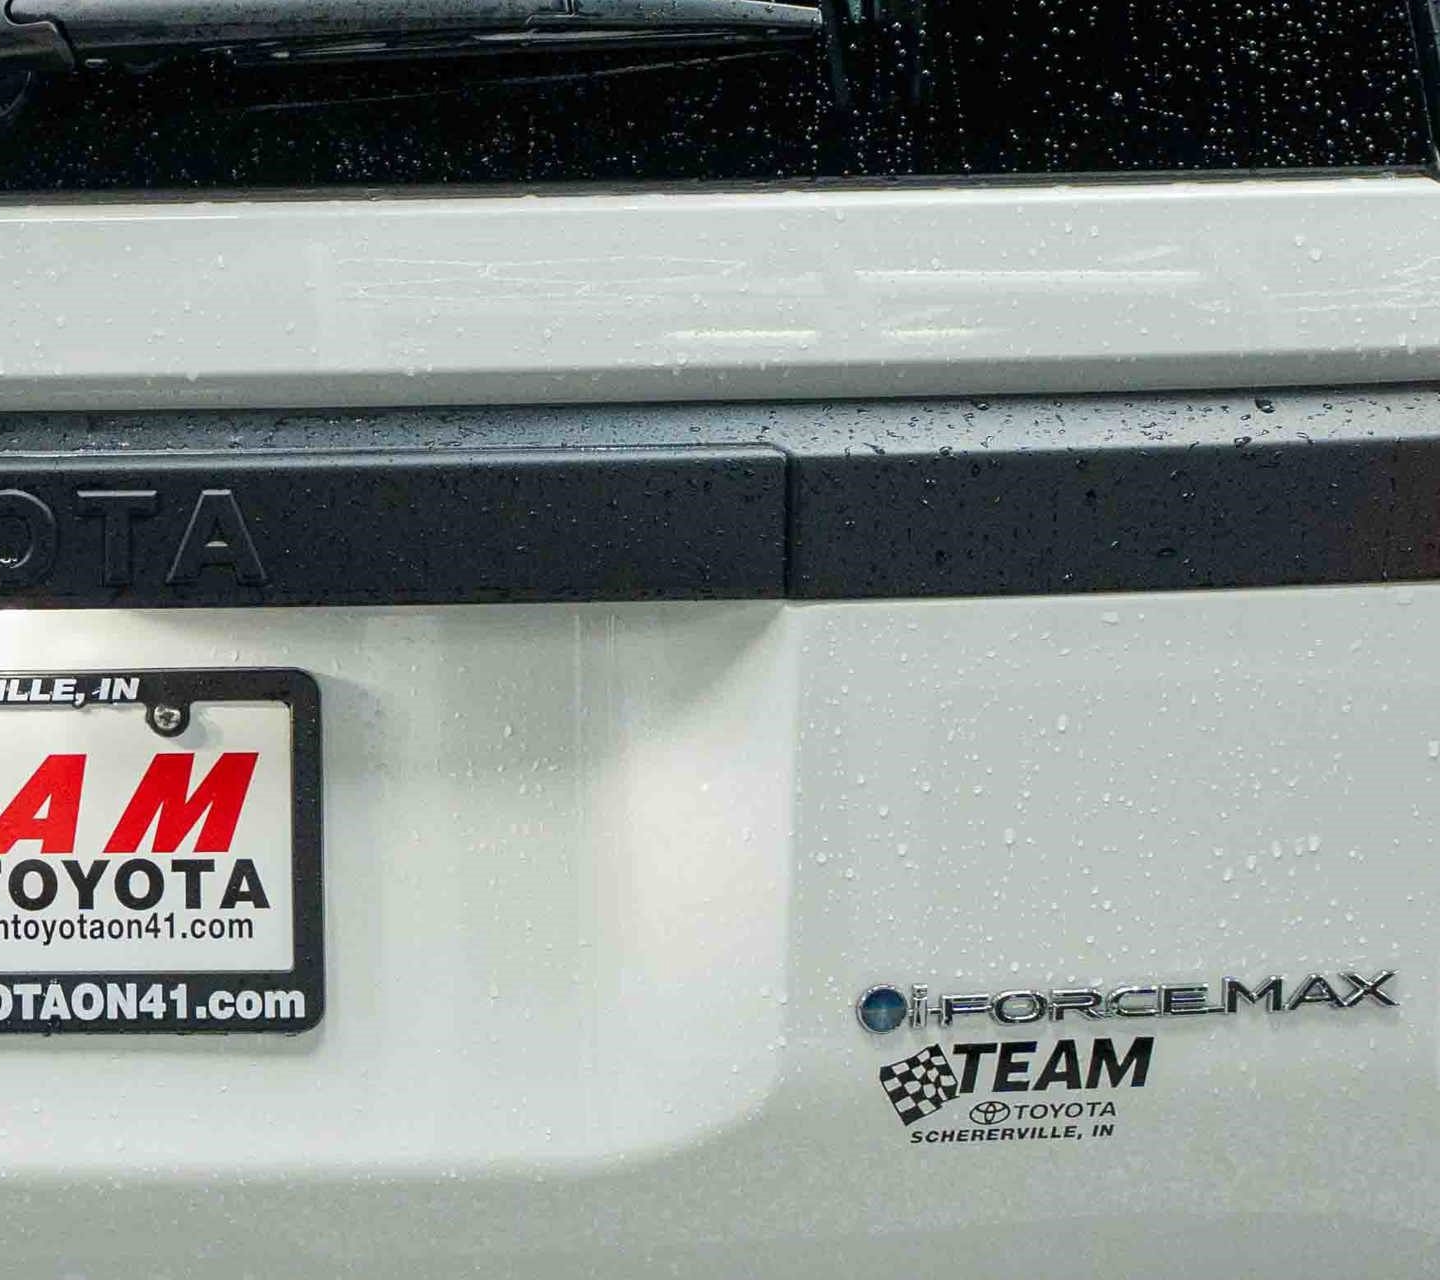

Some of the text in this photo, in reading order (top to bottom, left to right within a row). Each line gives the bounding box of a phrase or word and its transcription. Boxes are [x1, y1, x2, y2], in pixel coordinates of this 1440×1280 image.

[97, 676, 141, 700] IN
[1222, 968, 1401, 1014] MAX
[951, 1036, 1156, 1094] TEAM
[1013, 1101, 1117, 1121] TOYOTA
[909, 1123, 1115, 1145] SCHERERVILLE, IN
